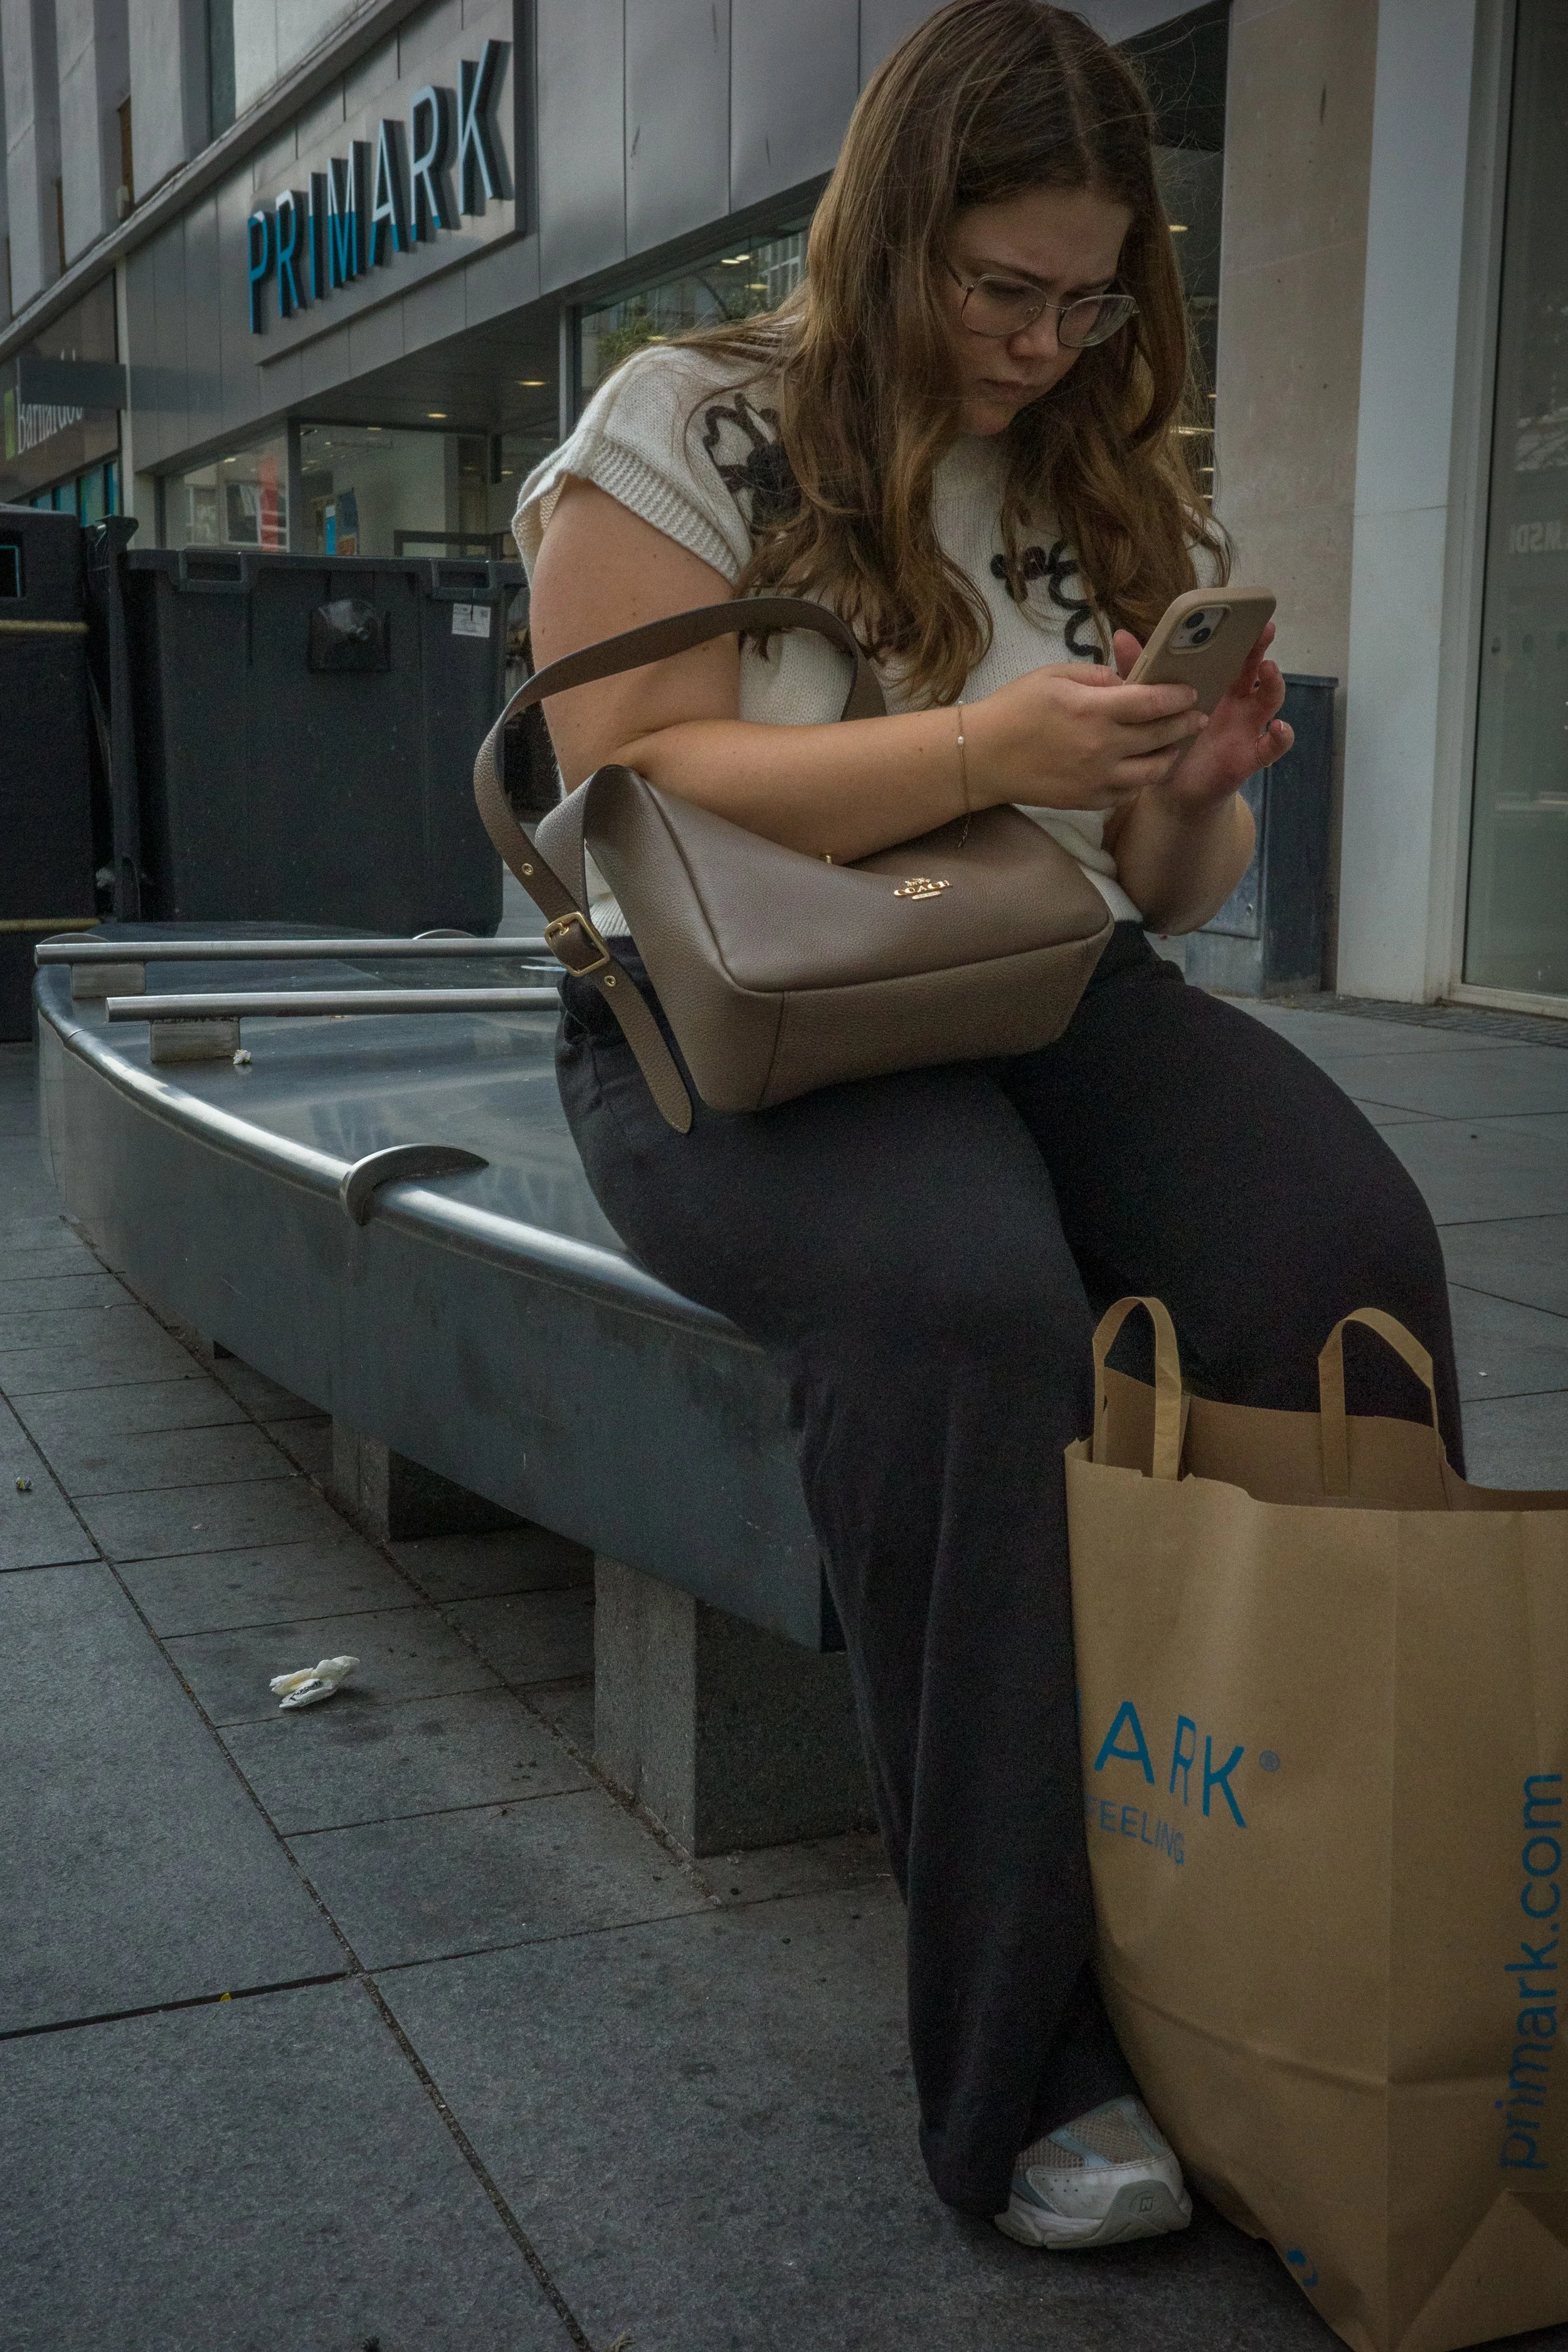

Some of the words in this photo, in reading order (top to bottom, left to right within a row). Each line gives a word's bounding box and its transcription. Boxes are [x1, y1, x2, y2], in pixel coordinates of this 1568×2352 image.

[248, 39, 511, 334] PRIMARK
[1076, 1688, 1246, 1828] ARK
[1495, 1773, 1563, 2170] primark.com
